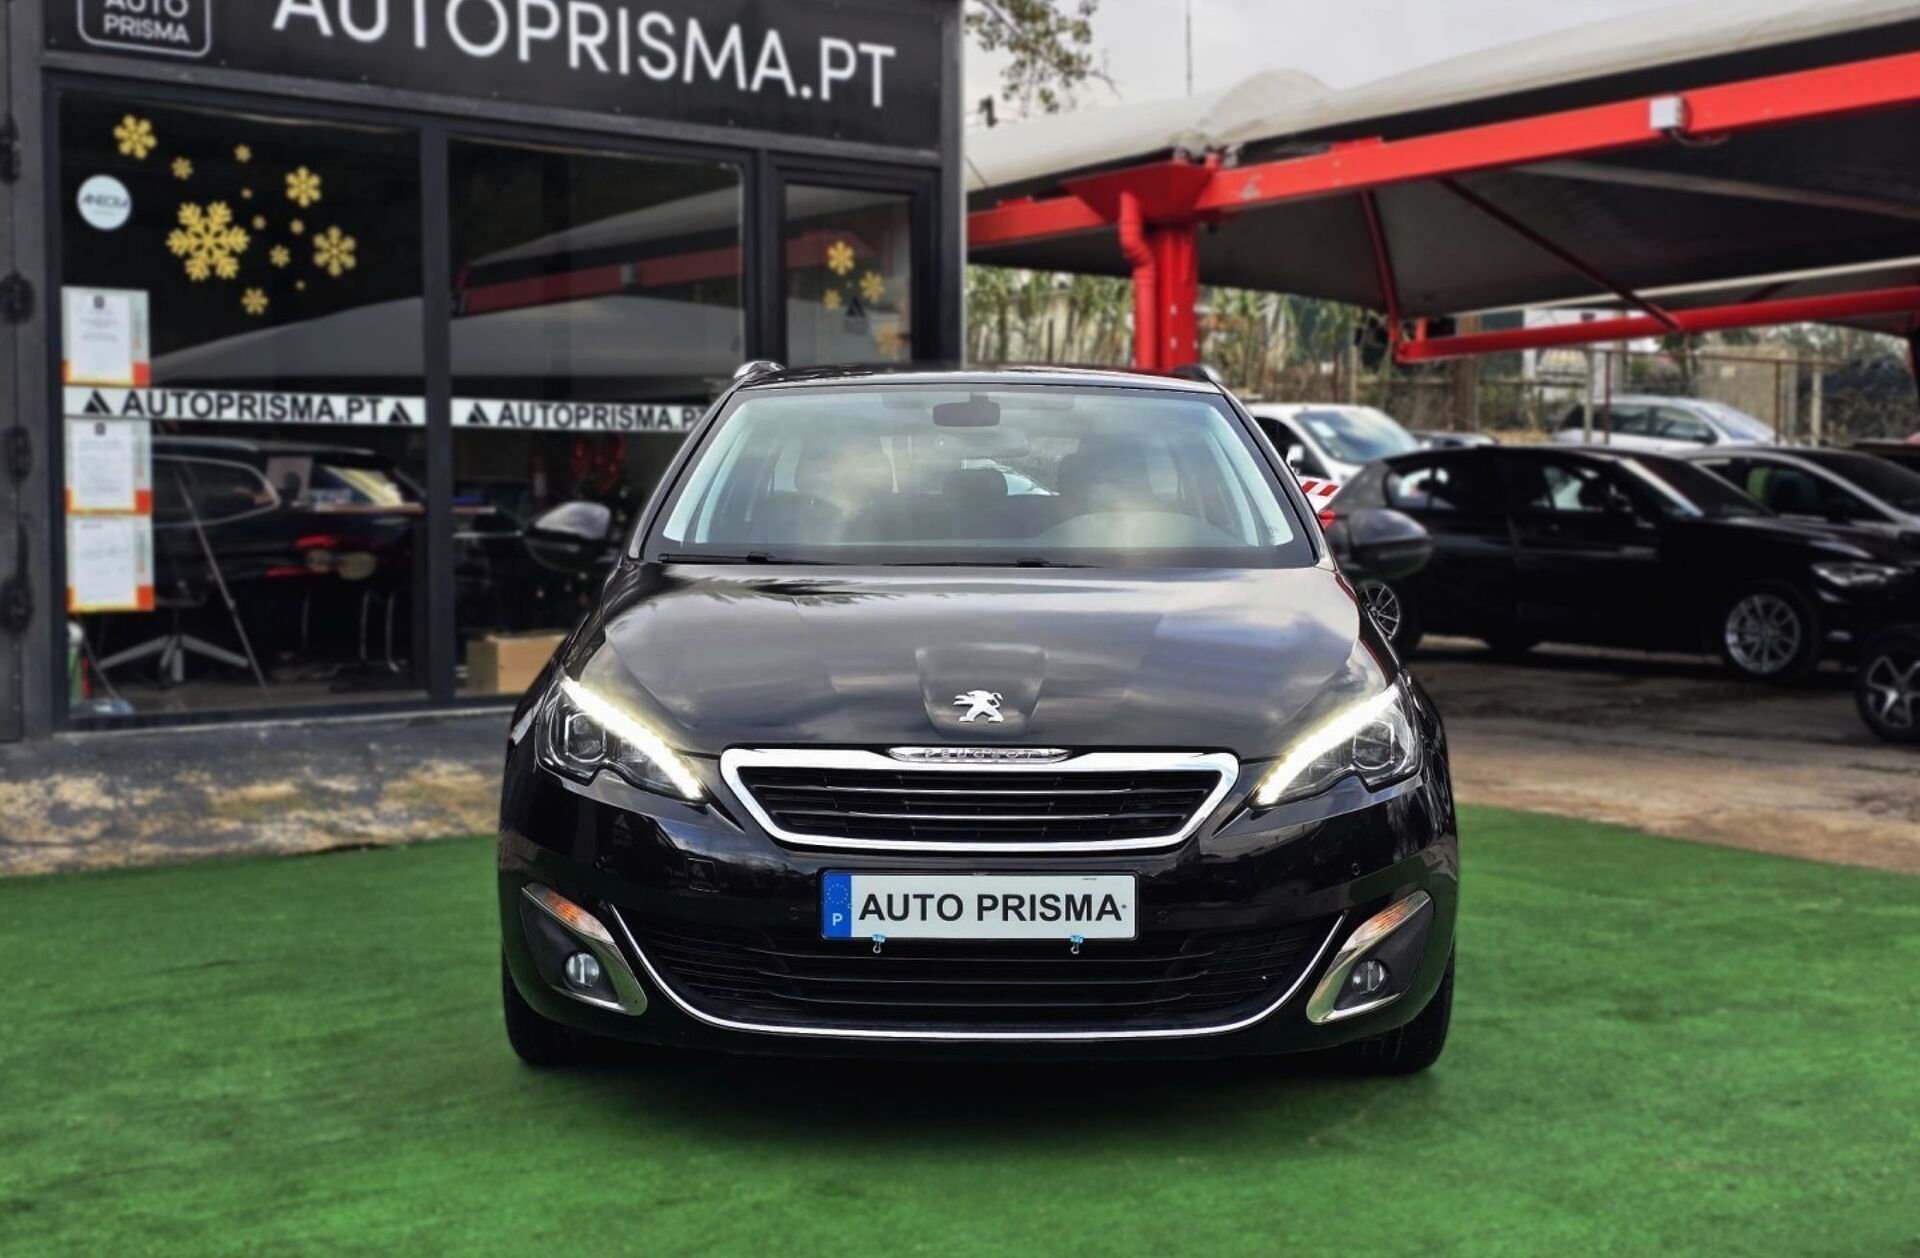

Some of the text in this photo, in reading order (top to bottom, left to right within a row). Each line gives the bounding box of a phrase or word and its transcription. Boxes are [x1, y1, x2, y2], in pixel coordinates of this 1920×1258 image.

[103, 13, 190, 44] PRISMA
[121, 389, 383, 422] AUTOPRISMA.PT
[497, 402, 706, 429] AUTOPRISMA.P
[832, 912, 843, 927] P
[858, 892, 1122, 922] AUTO PRISMA
